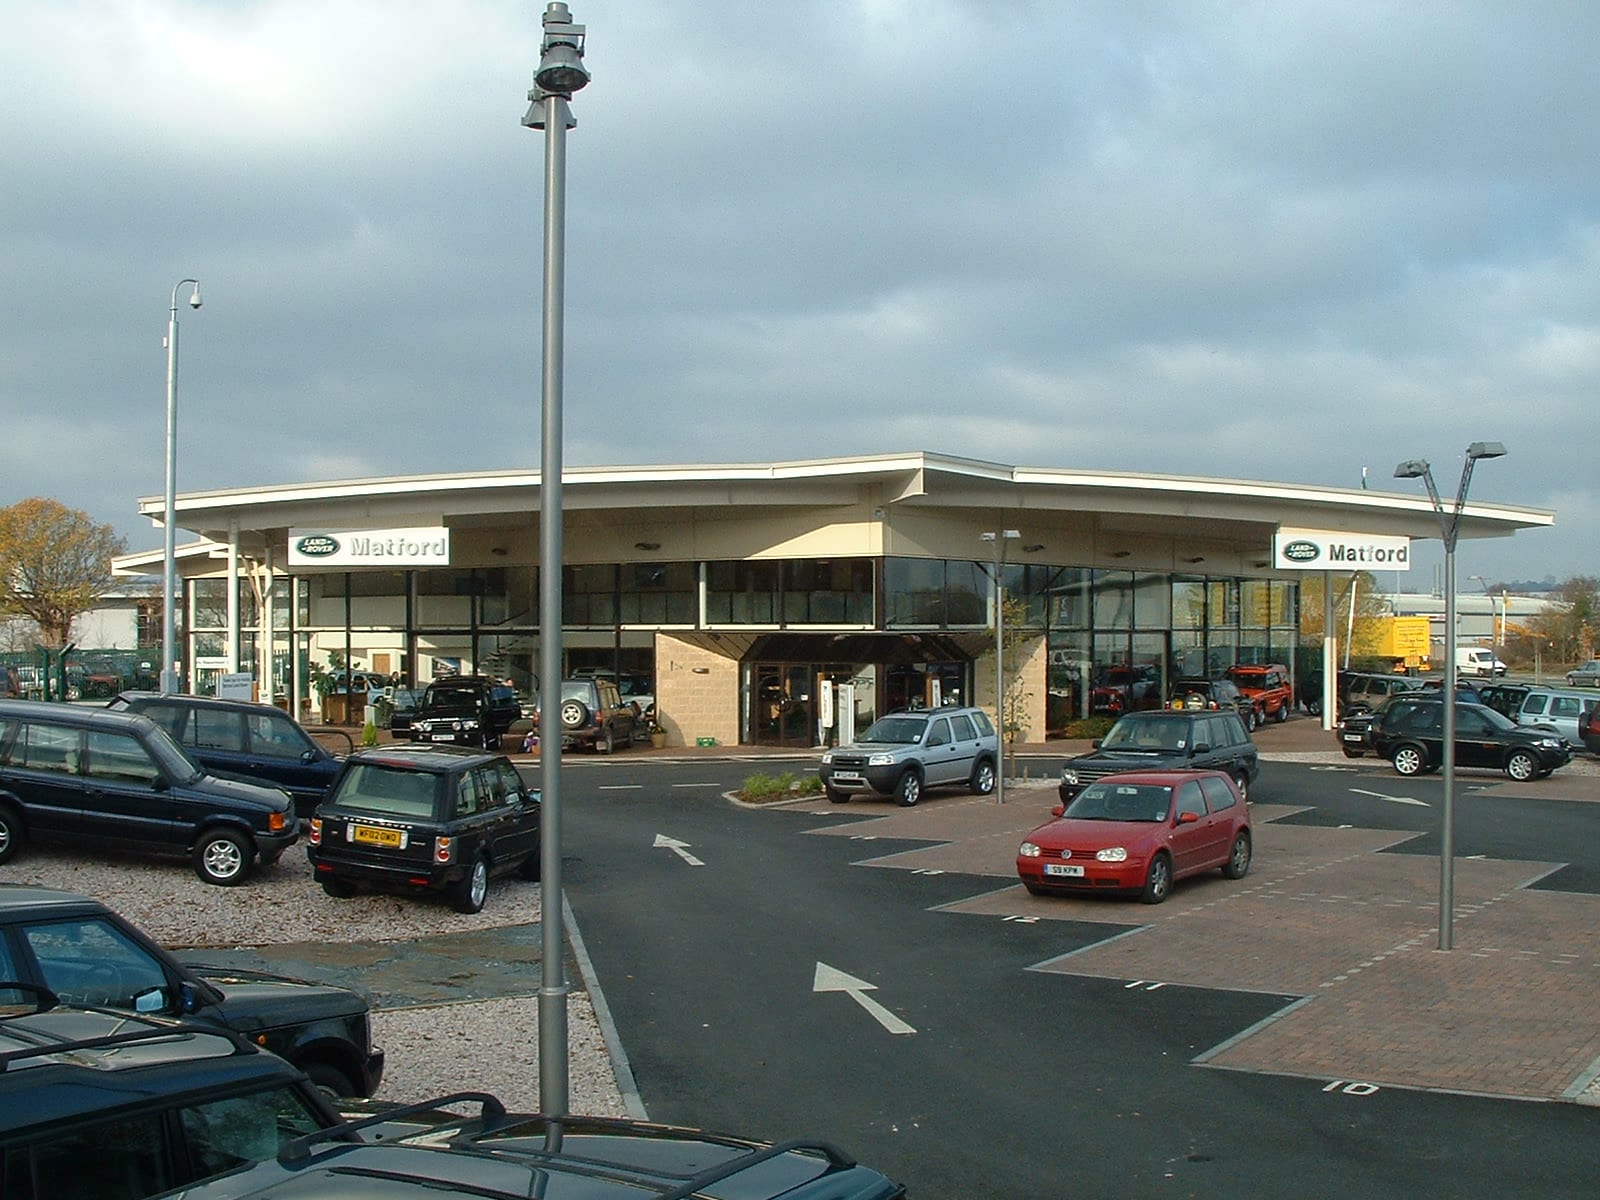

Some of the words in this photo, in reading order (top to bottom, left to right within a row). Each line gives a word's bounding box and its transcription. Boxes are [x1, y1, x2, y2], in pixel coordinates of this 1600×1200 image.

[304, 538, 327, 546] LAND
[305, 545, 334, 553] ROVER
[351, 537, 445, 556] Matford
[1329, 544, 1407, 562] Matford
[1321, 1080, 1380, 1096] 10
